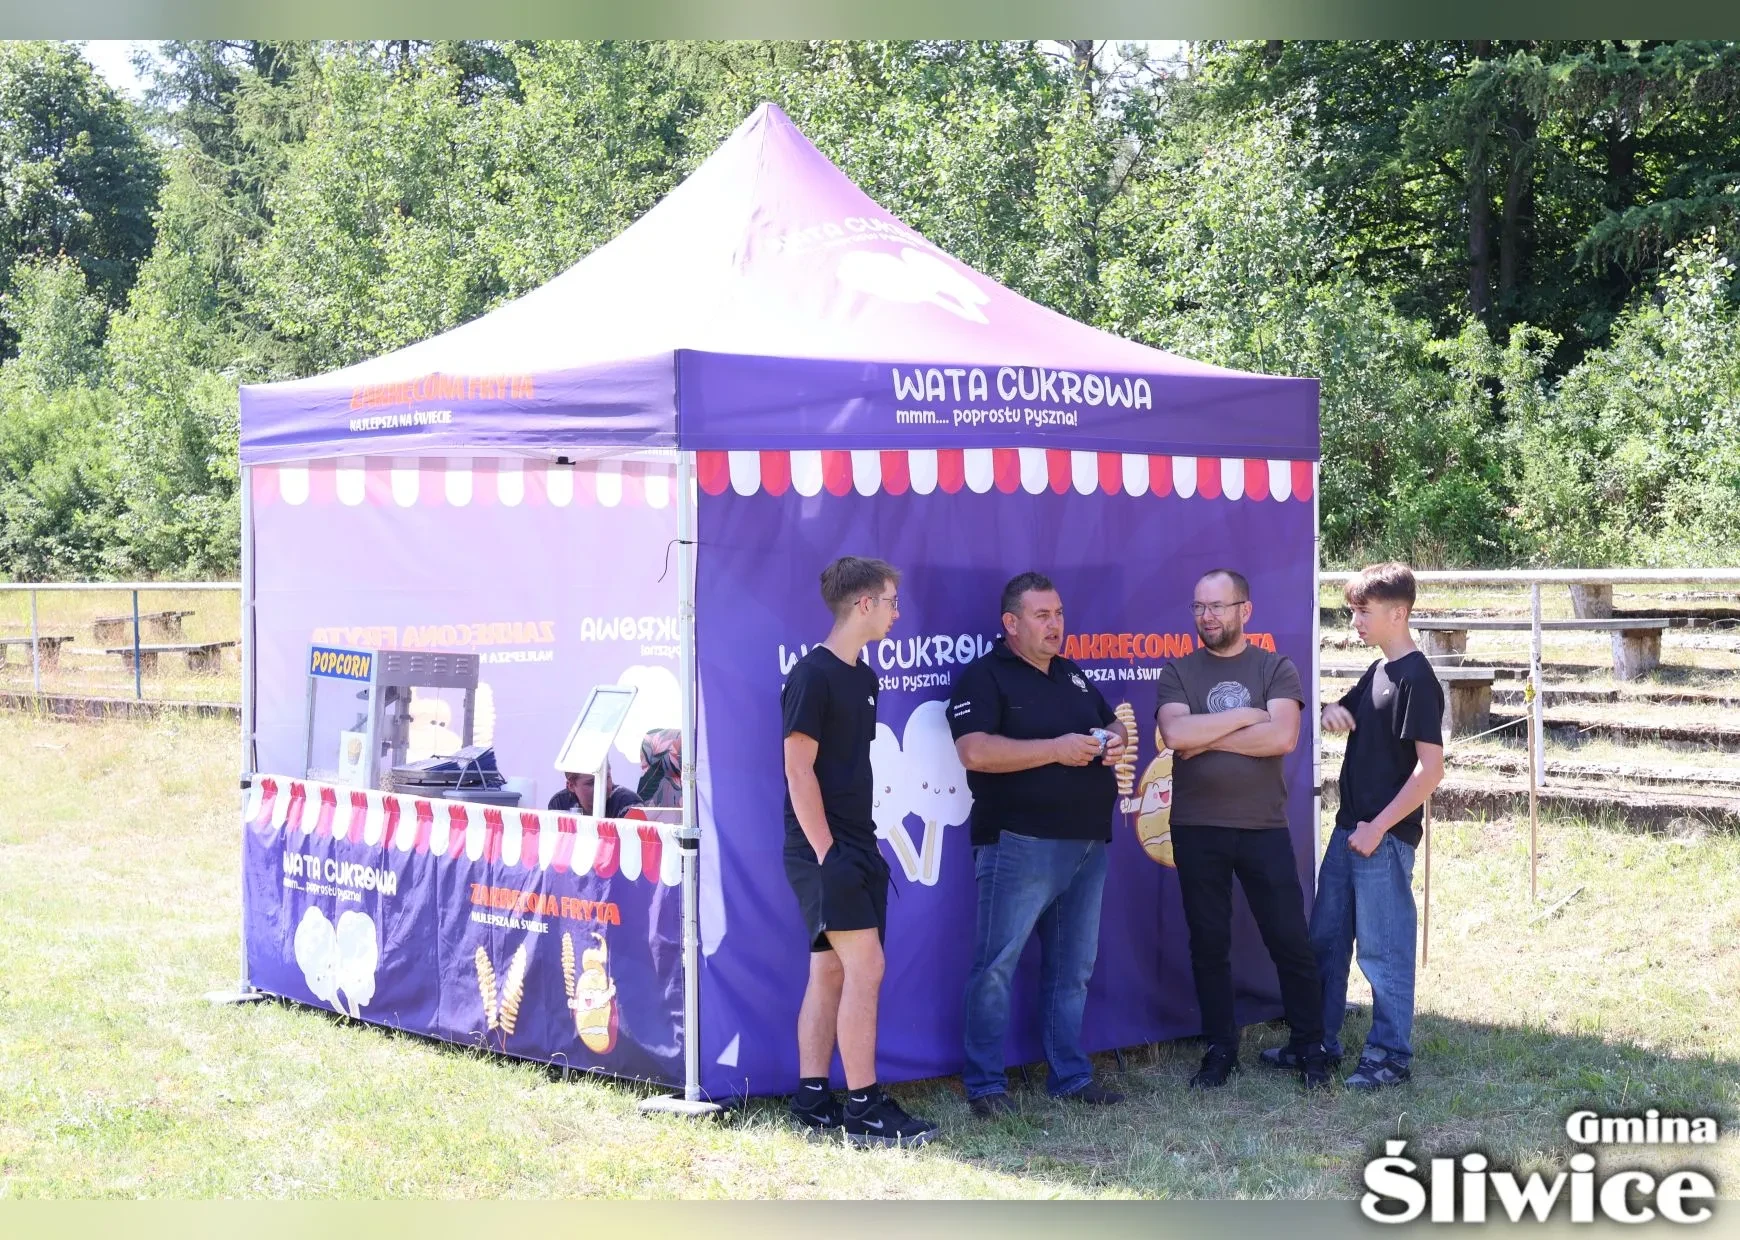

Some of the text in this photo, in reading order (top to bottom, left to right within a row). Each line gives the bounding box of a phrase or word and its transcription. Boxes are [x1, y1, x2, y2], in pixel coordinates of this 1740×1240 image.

[893, 367, 1152, 410] WATA CUKROWA
[350, 410, 453, 432] NAJLEPSZA NA ŚWIECIE
[953, 406, 1021, 426] poprostu
[1024, 408, 1078, 428] pyszna!
[877, 634, 1002, 671] CUKROW
[1063, 633, 1194, 665] AKRĘCONA
[311, 651, 371, 678] POPCORN
[1118, 667, 1136, 681] NA
[903, 671, 950, 692] pyszna!
[283, 851, 397, 896] WATA CUKROWA
[560, 896, 621, 926] FRYTA
